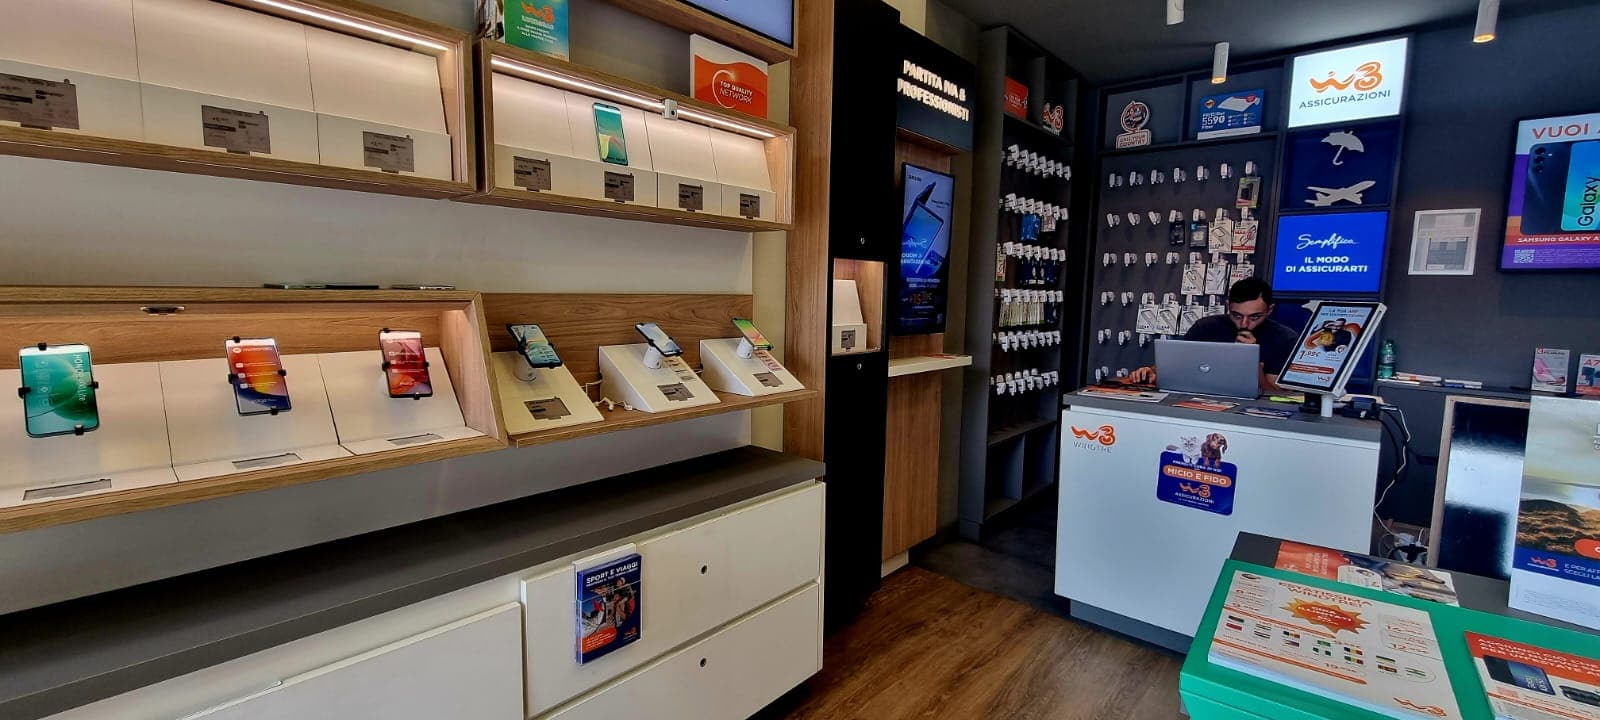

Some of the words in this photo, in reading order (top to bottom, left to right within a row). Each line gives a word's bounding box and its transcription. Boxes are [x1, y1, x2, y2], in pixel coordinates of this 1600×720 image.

[903, 59, 943, 91] PARTITA
[944, 79, 958, 99] IVA
[720, 80, 731, 89] TOP
[731, 84, 753, 97] QUALITY
[720, 88, 753, 105] NETWORK
[897, 78, 969, 122] PROFESSIONISTI
[1299, 89, 1391, 109] ASSICURAZIONI
[1202, 115, 1226, 126] 5590
[1532, 123, 1589, 140] VUOI
[1120, 139, 1146, 148] COUNTRY
[1578, 176, 1600, 227] Galaxy
[1296, 232, 1360, 249] Semplifica
[1517, 236, 1557, 244] SAMSUNG
[1558, 235, 1592, 243] GALAXY
[1304, 256, 1314, 264] IL
[1316, 256, 1349, 264] MODO
[1285, 265, 1296, 273] DI
[1298, 265, 1368, 273] ASSICURARTI
[72, 353, 84, 380] HONOR
[1073, 440, 1112, 454] WINDTRE
[1167, 467, 1194, 478] MICIO
[1203, 474, 1227, 485] FIDO
[586, 571, 609, 584] SPORT
[616, 561, 638, 573] VIAGGI
[1564, 568, 1591, 579] SCEGLI
